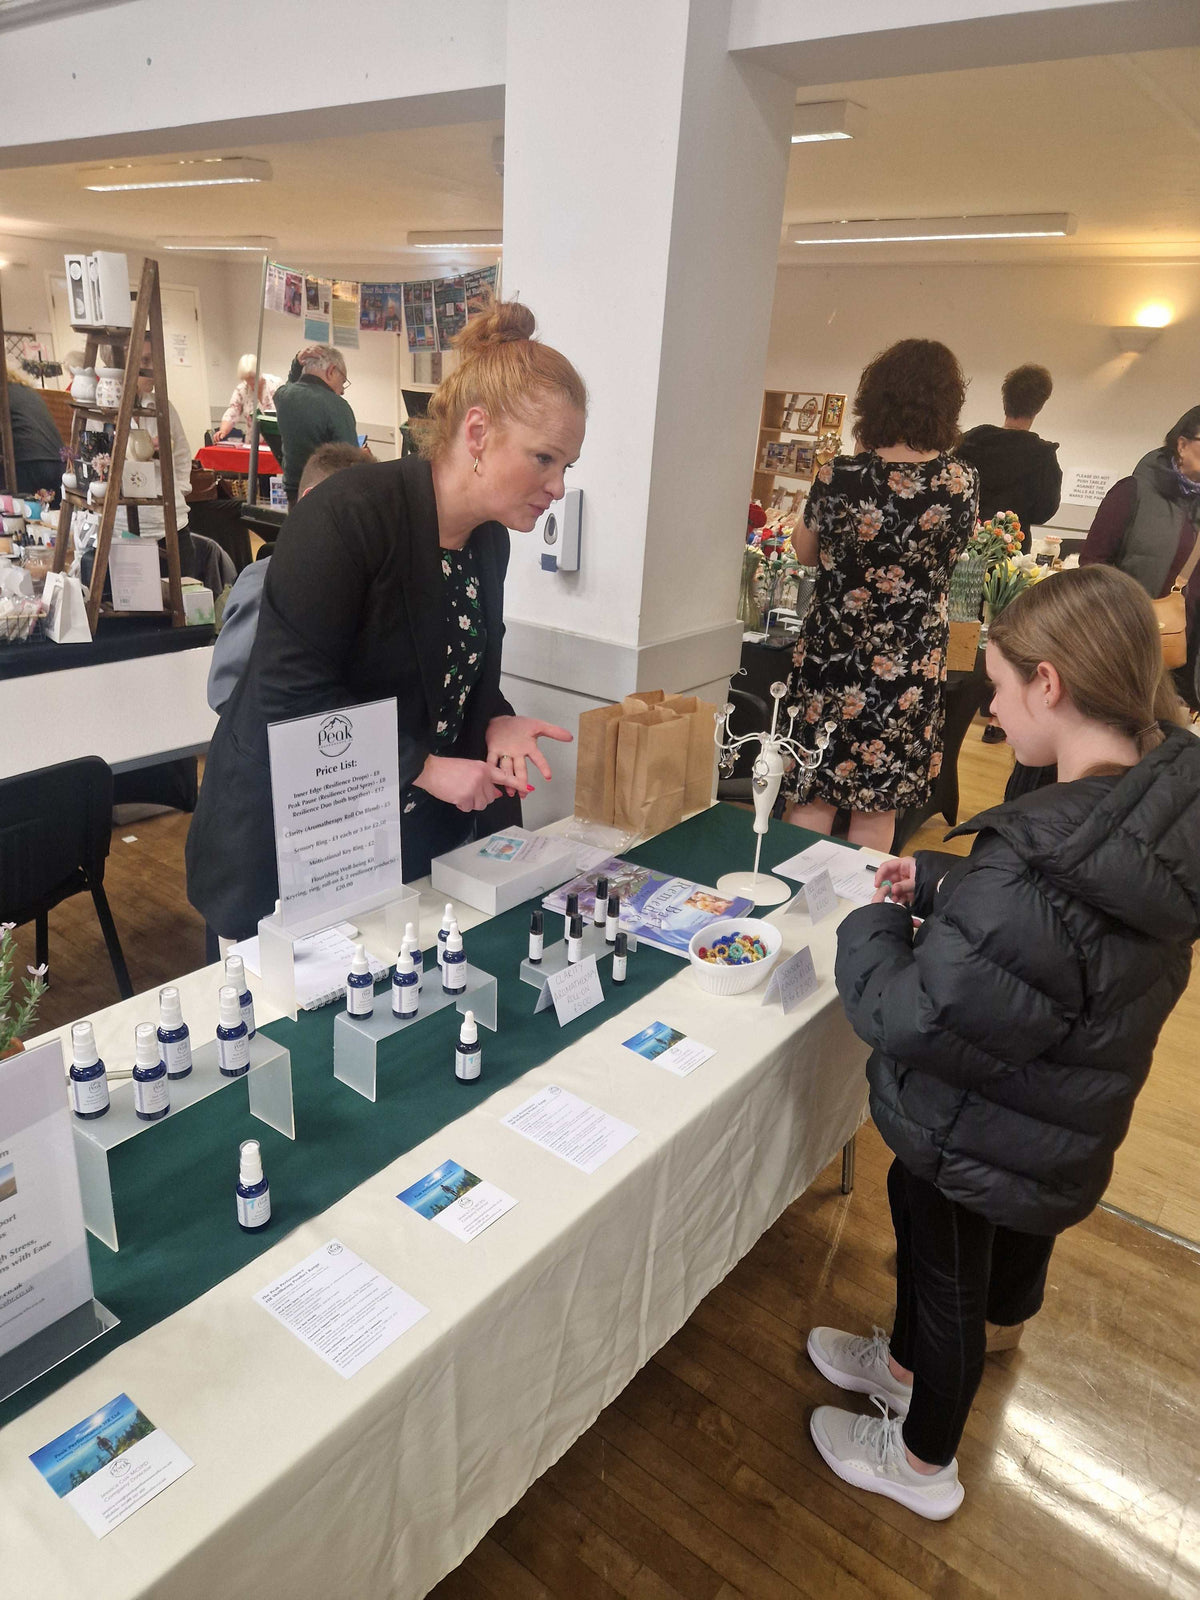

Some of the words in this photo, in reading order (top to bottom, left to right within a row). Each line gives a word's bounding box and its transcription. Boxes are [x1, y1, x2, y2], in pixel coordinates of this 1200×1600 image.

[316, 766, 338, 777] Price
[340, 760, 357, 770] List:
[288, 802, 300, 810] Peak
[302, 797, 316, 806] Pause
[319, 789, 346, 801] (Resilience
[347, 784, 358, 792] Oral
[360, 779, 376, 789] Spray)
[293, 791, 308, 799] Inner
[310, 787, 322, 795] Edge
[323, 779, 351, 790] (Resilience
[352, 772, 369, 782] Drops)
[292, 806, 319, 817] Resilience
[321, 802, 332, 810] Duo
[333, 797, 347, 806] (both
[347, 790, 370, 802] together)
[285, 829, 303, 838] Clarity
[305, 817, 343, 832] (Aromatherapy
[344, 812, 354, 820] Roll
[294, 844, 314, 854] Sensory
[340, 831, 352, 839] each
[309, 852, 341, 866] Motivational
[342, 848, 351, 856] Key
[353, 844, 364, 852] Ring
[311, 869, 339, 883] Flourishing
[626, 880, 693, 925] Remedies
[650, 904, 683, 930] Bach
[10, 1240, 37, 1257] Stress,
[12, 1252, 31, 1267] with
[34, 1240, 52, 1254] Ease
